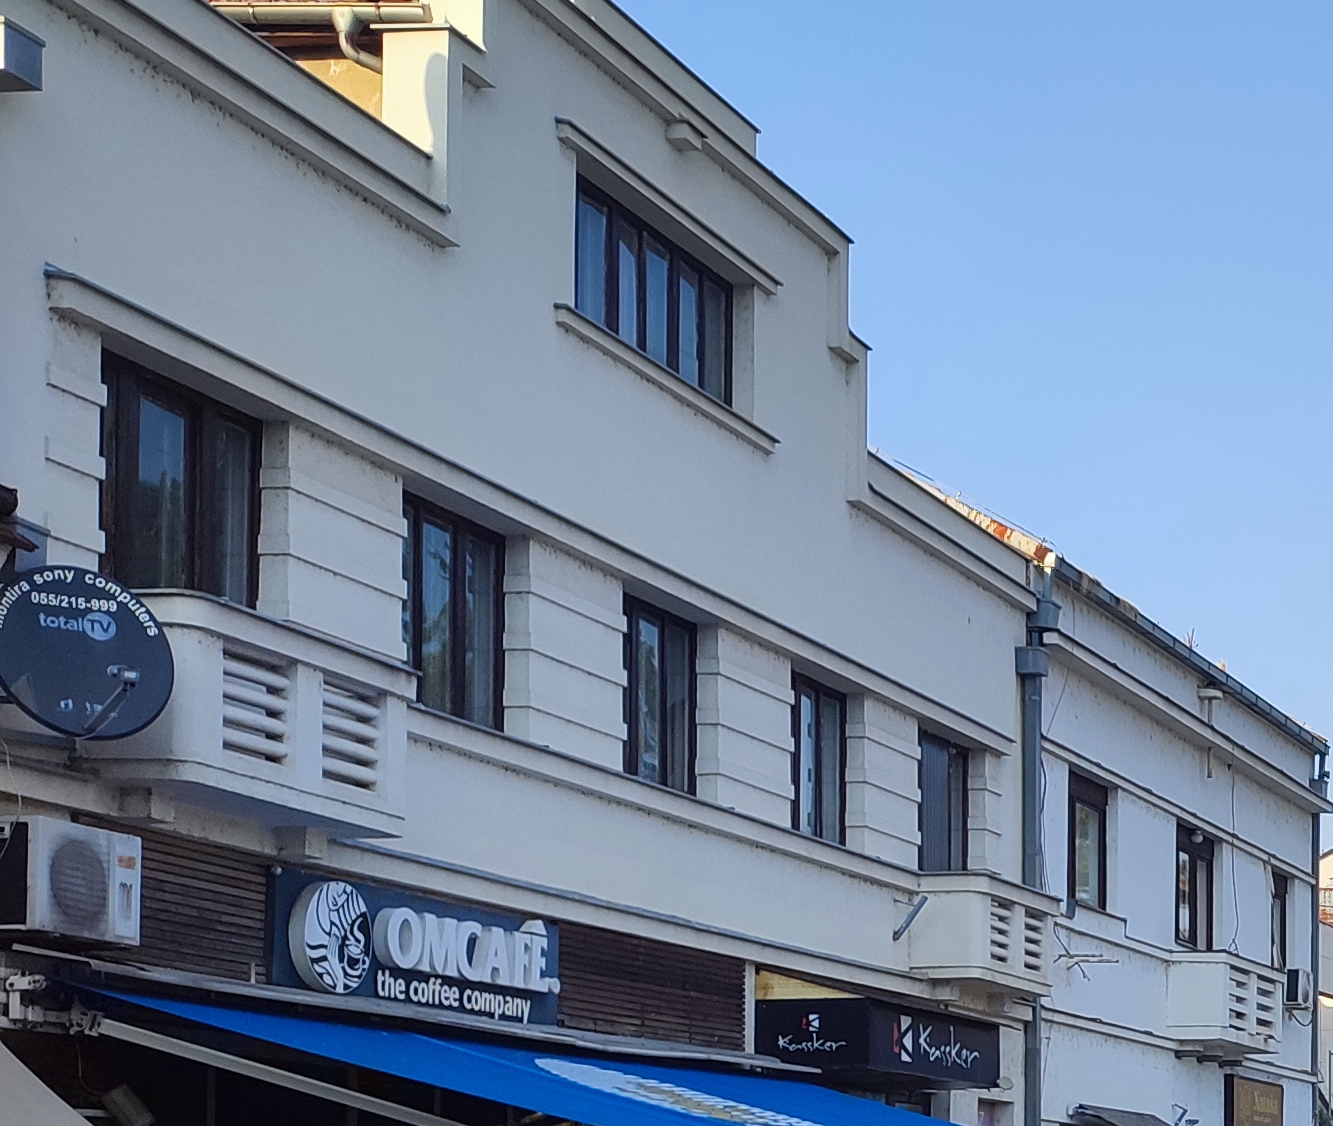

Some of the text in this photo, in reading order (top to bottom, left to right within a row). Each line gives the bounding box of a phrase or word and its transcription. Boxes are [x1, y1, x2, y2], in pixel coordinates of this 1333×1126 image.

[31, 592, 118, 612] 055/215-999
[33, 569, 75, 585] sony
[84, 573, 159, 637] computers
[376, 970, 532, 1025] the coffee company
